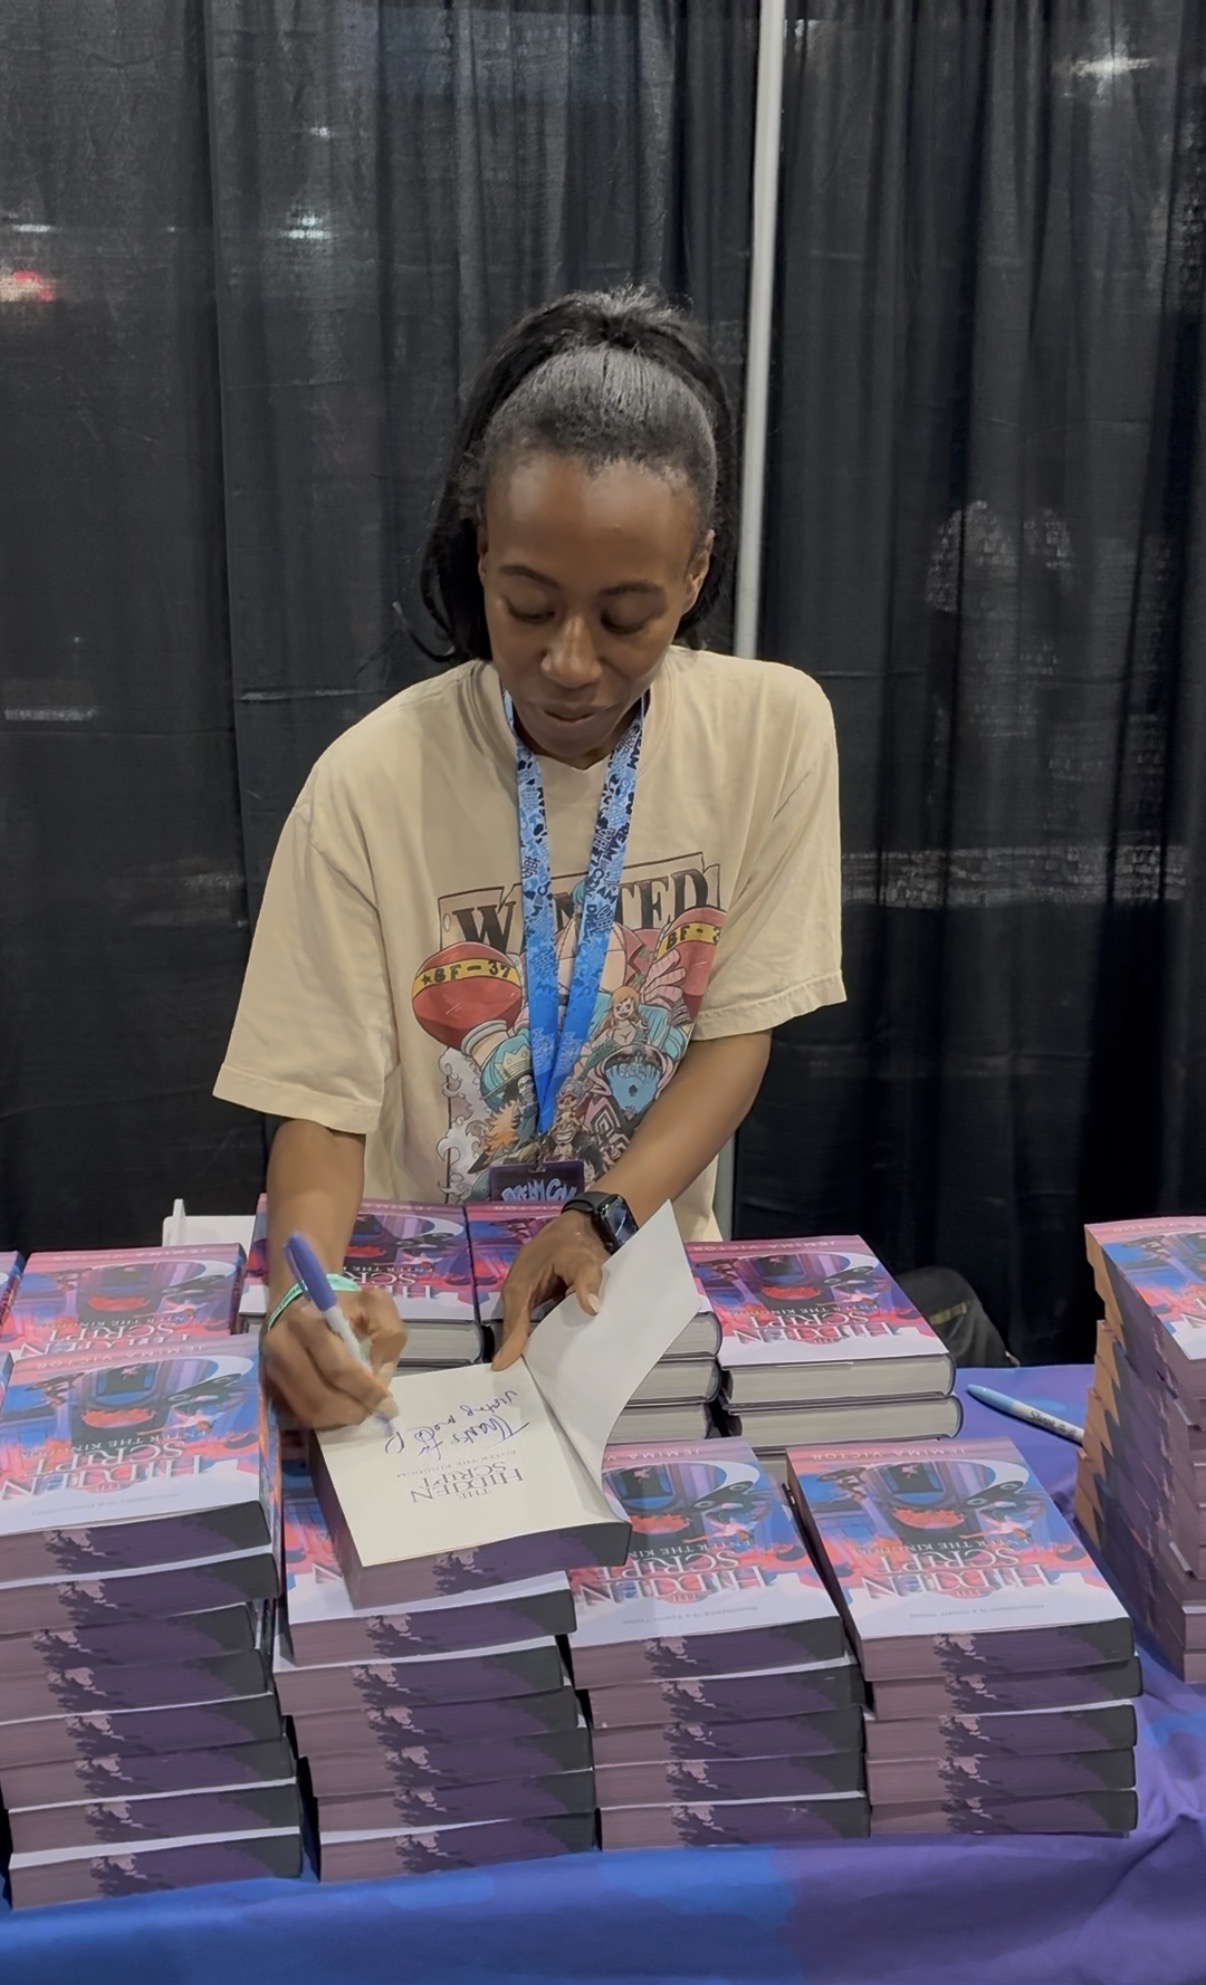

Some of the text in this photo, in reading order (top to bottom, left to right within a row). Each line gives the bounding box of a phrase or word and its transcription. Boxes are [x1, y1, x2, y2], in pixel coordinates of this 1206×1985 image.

[452, 867, 709, 950] WNTED
[693, 1240, 835, 1252] JEMIMA VICTOR
[343, 1271, 417, 1286] SCR
[750, 1311, 869, 1329] SCRIPT
[799, 1306, 828, 1314] THE
[733, 1320, 895, 1344] HIDDEN
[36, 1345, 204, 1369] JEMIMA VICTOR
[107, 1437, 144, 1448] THE
[627, 1448, 700, 1460] JEMIMA
[811, 1447, 966, 1461] JEMIMA VICTOR
[35, 1441, 185, 1473] SCRIPT
[0, 1455, 204, 1500] HIDDEN
[410, 1468, 523, 1503] HIDDEN
[419, 1461, 507, 1489] SCRIPT
[659, 1544, 694, 1556] THE
[937, 1539, 969, 1551] THE
[599, 1550, 739, 1581] SCRIPT
[874, 1546, 1019, 1575] SCRIPT
[579, 1565, 766, 1606] HIDDEN
[860, 1563, 1051, 1600] HIDDEN
